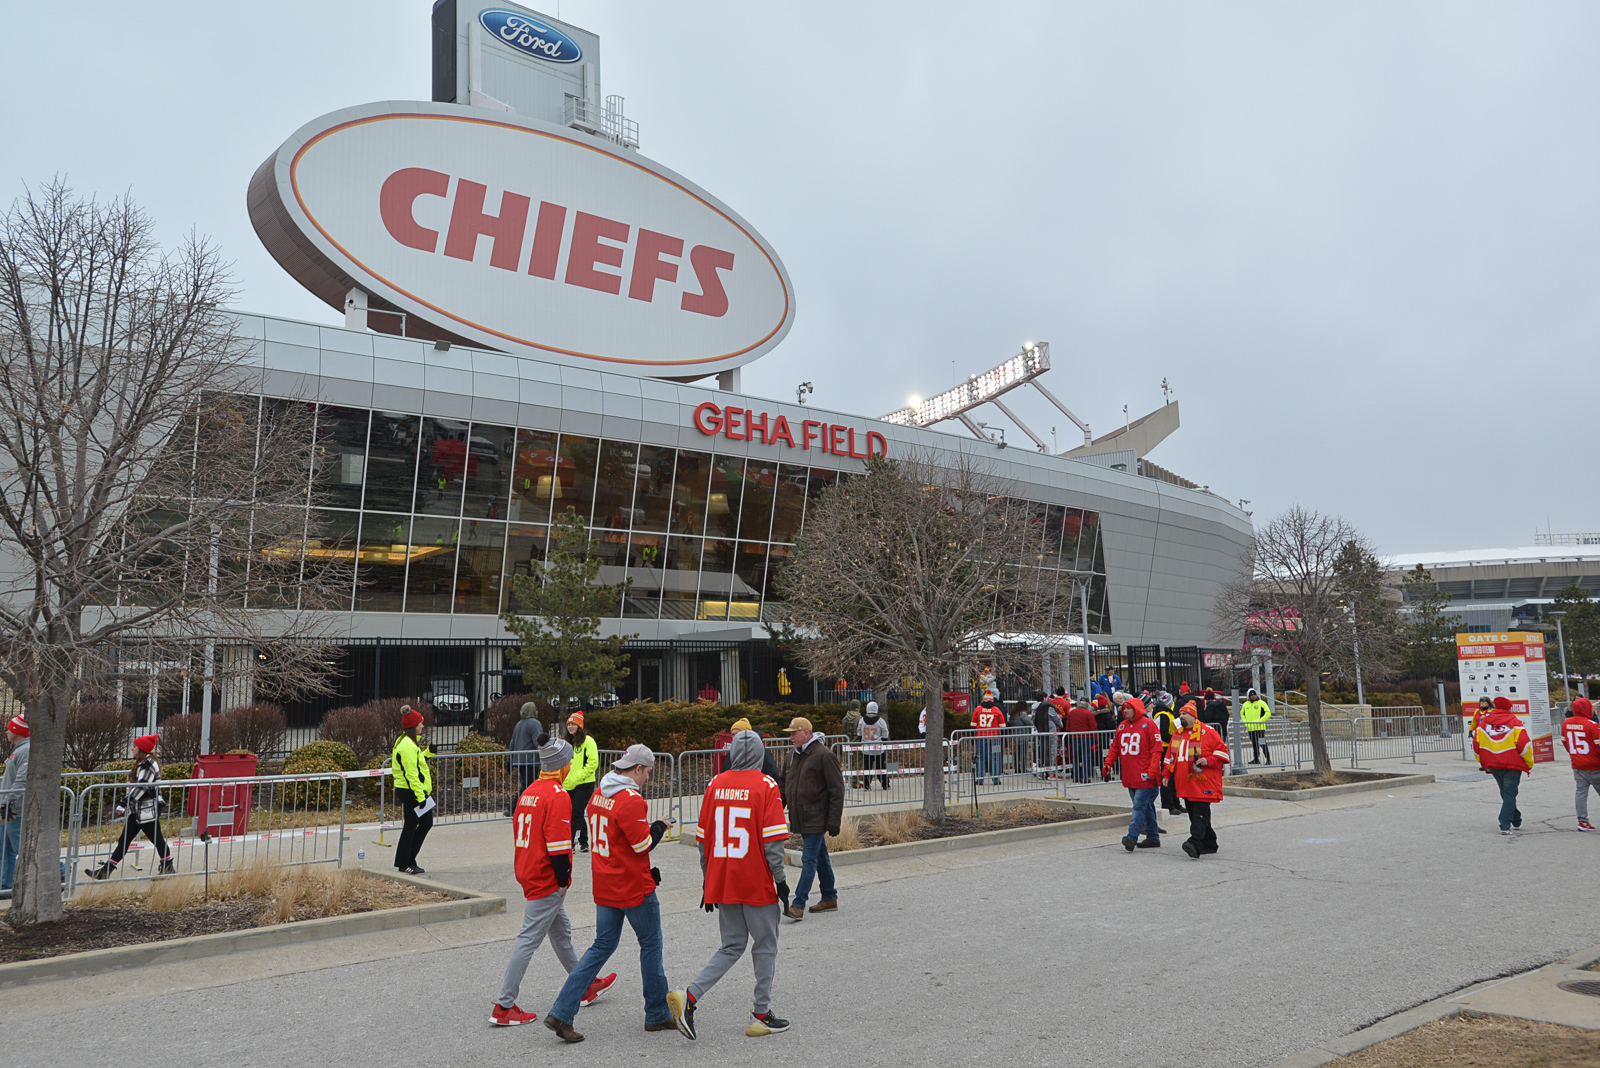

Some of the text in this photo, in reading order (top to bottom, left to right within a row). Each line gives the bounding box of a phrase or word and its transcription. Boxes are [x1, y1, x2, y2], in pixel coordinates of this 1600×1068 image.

[500, 16, 561, 58] Ford
[380, 167, 735, 318] CHIEFS
[694, 402, 888, 460] GEHA FIELD
[1468, 634, 1509, 642] GATE C
[979, 714, 995, 727] 87
[863, 727, 879, 741] 87
[1120, 732, 1141, 756] 58
[1566, 731, 1590, 755] 15
[591, 794, 616, 811] MAHOMES
[714, 788, 750, 801] MAHOMES
[515, 812, 532, 849] 13
[590, 813, 610, 858] 15
[713, 805, 752, 859] 15
